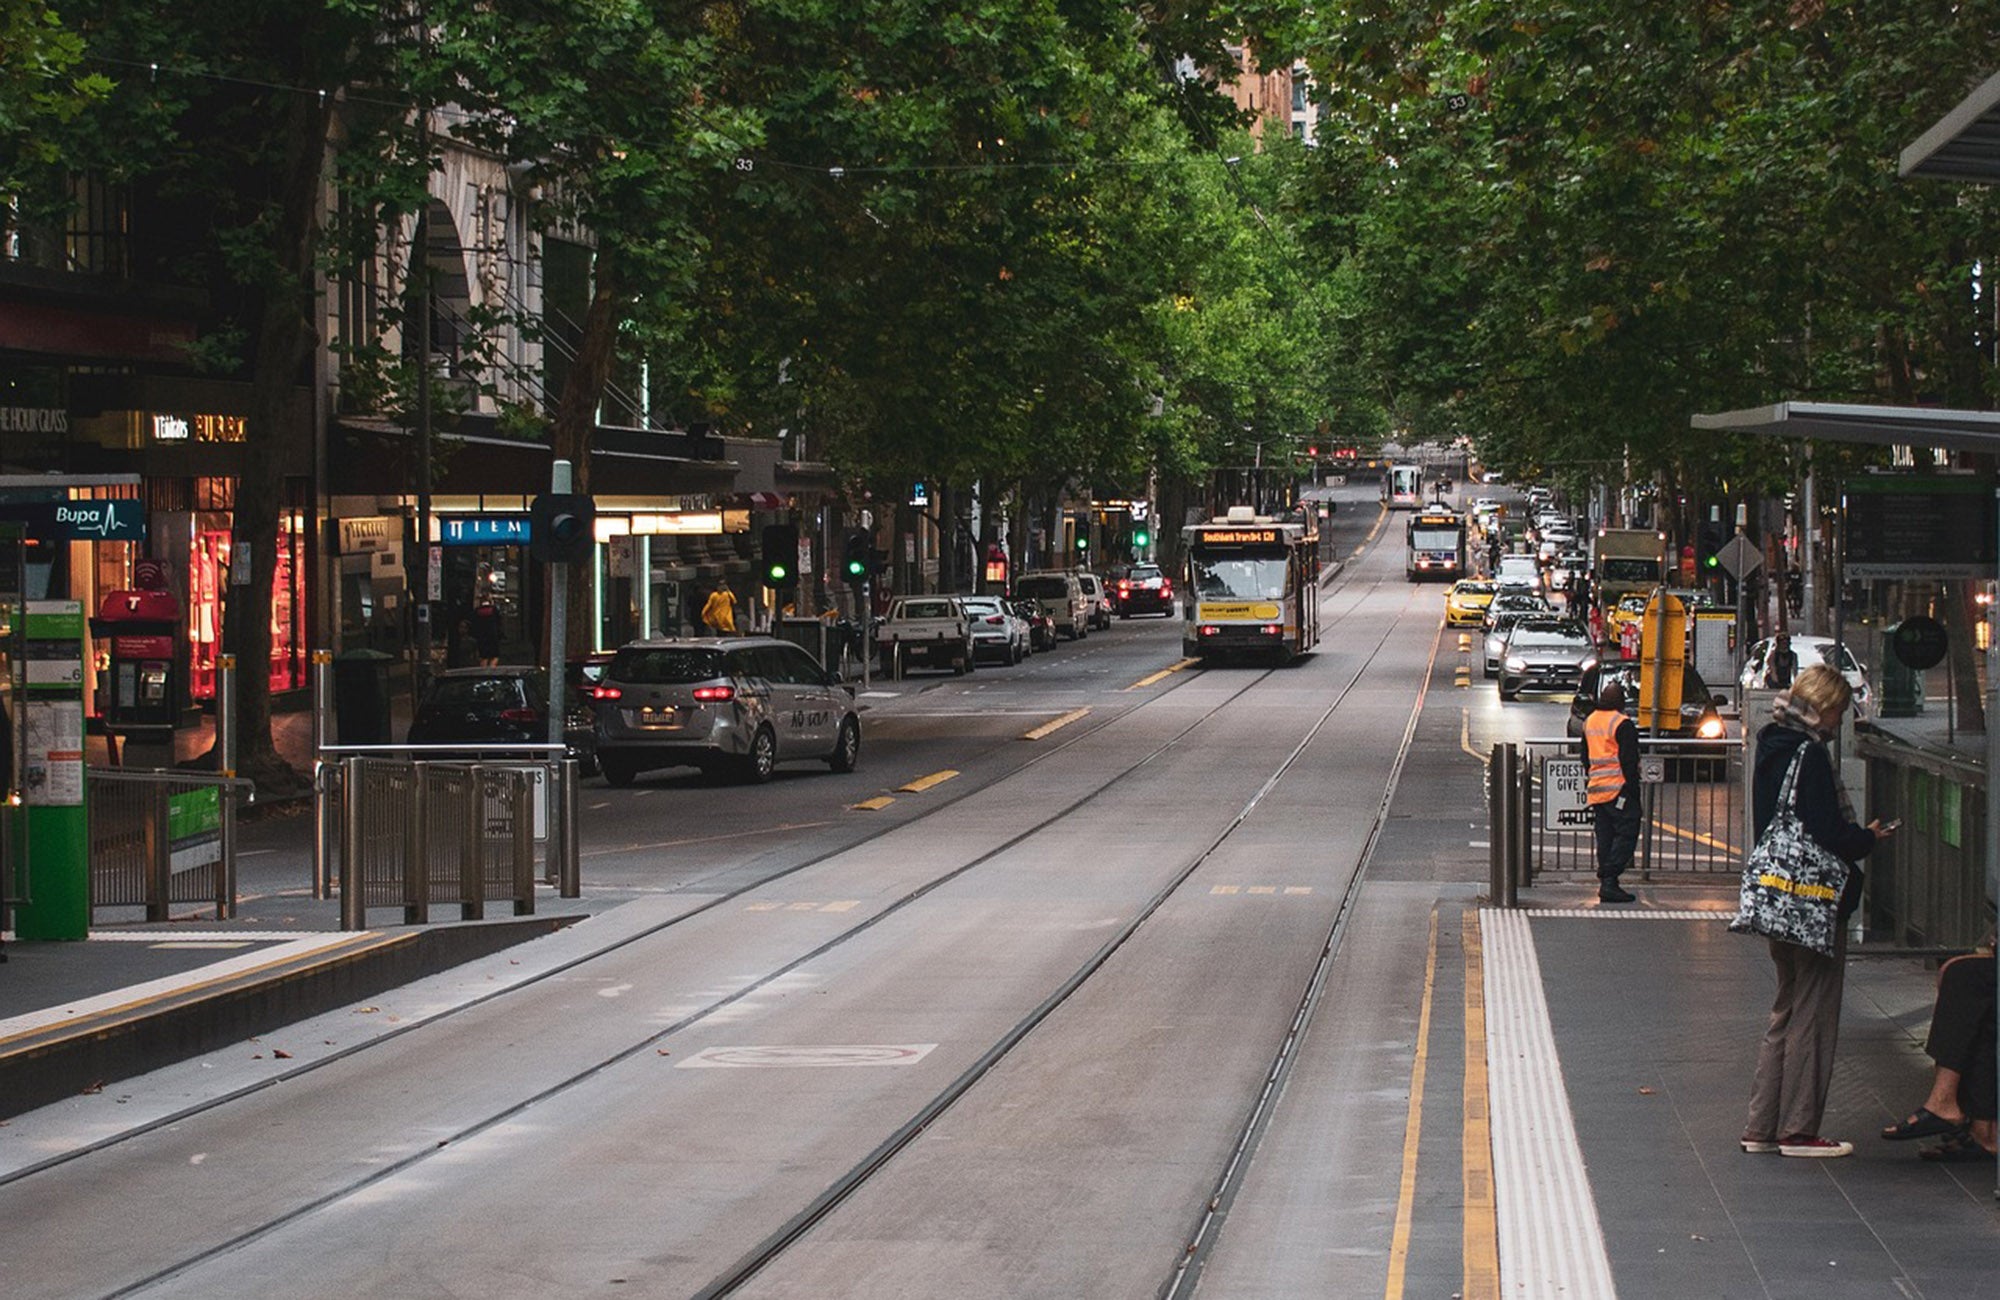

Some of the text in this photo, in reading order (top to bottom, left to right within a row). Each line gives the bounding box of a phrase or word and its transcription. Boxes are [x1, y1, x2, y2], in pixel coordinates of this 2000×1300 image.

[1449, 95, 1467, 110] 33
[735, 158, 754, 172] 33
[56, 506, 100, 524] Bupa
[72, 668, 81, 681] 6
[1557, 778, 1578, 791] GIVE
[1575, 791, 1587, 804] TO
